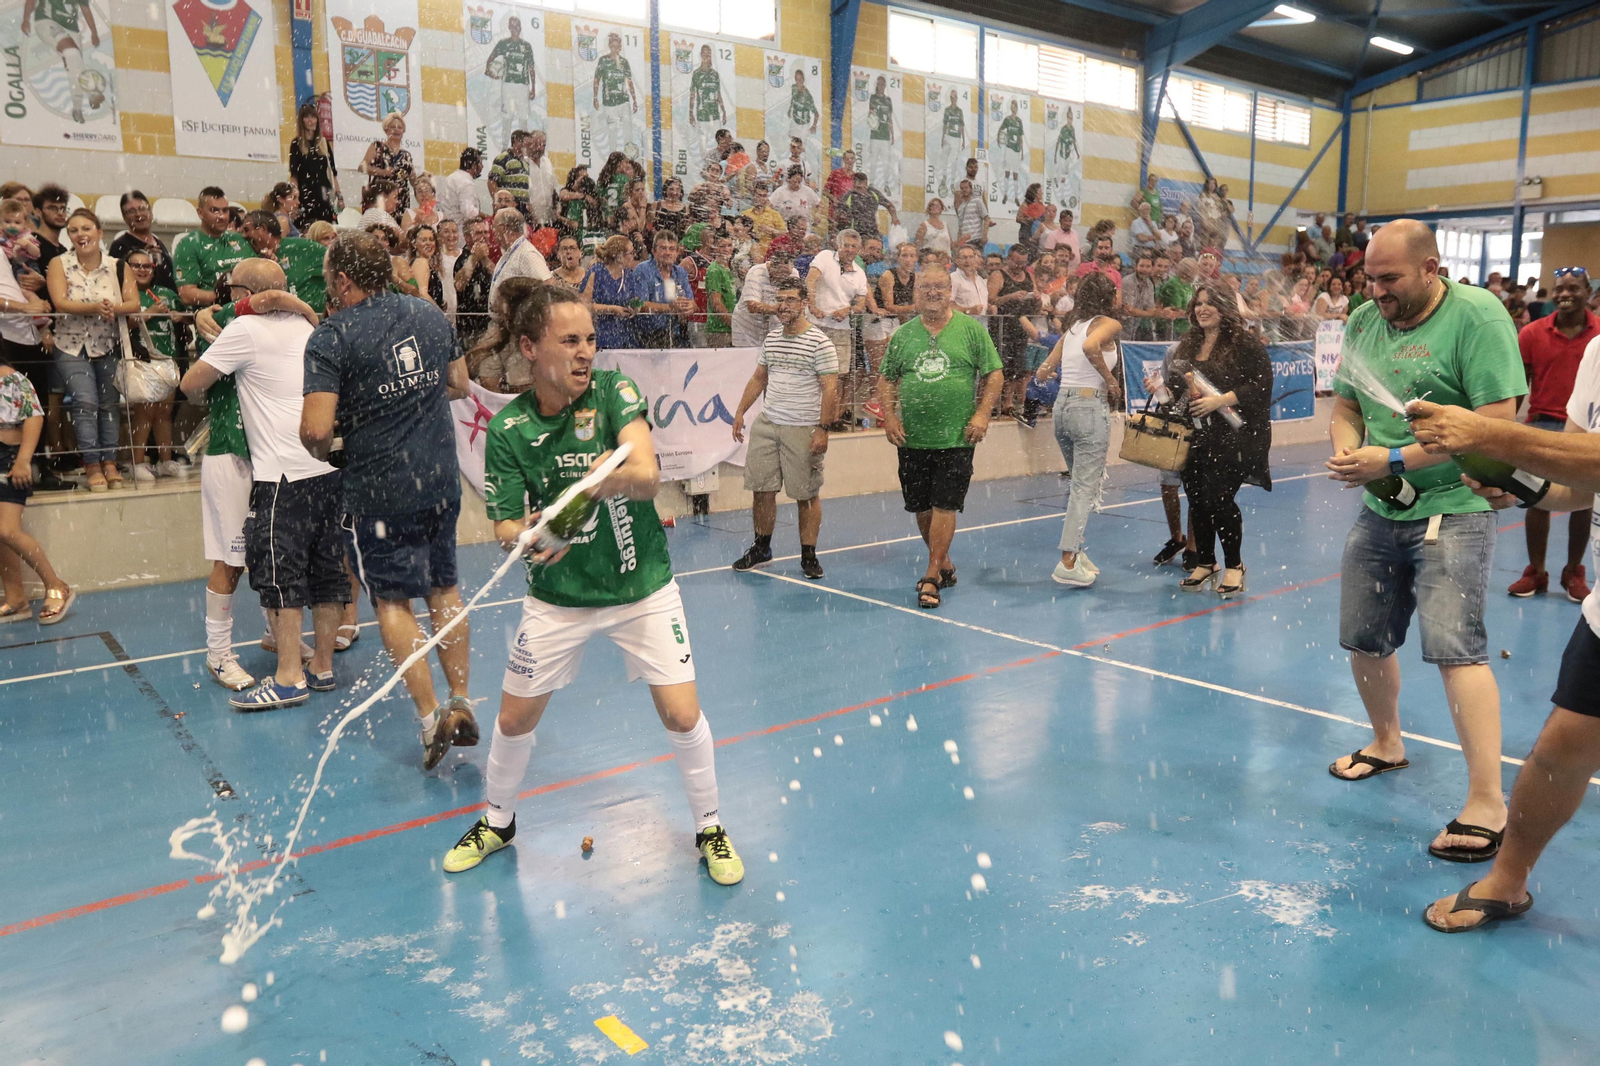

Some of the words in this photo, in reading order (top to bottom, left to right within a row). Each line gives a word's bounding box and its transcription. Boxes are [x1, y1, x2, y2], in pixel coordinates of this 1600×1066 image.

[531, 17, 540, 30] 6
[624, 34, 638, 47] 11
[719, 49, 732, 61] 12
[811, 65, 819, 76] 8
[4, 45, 27, 119] OGALLA
[890, 78, 900, 88] 21
[962, 90, 968, 100] 4
[1019, 99, 1029, 110] 15
[1076, 110, 1082, 120] 3
[243, 126, 277, 136] FANUM
[580, 114, 593, 169] LORENA
[676, 149, 688, 175] BIBI
[855, 142, 863, 173] RIDAD
[926, 164, 935, 194] PELU
[990, 181, 999, 202] EVA
[1271, 359, 1314, 377] EPORTES
[378, 369, 440, 395] OLYMPUS
[612, 493, 637, 572] lefurgo
[671, 623, 685, 645] 5
